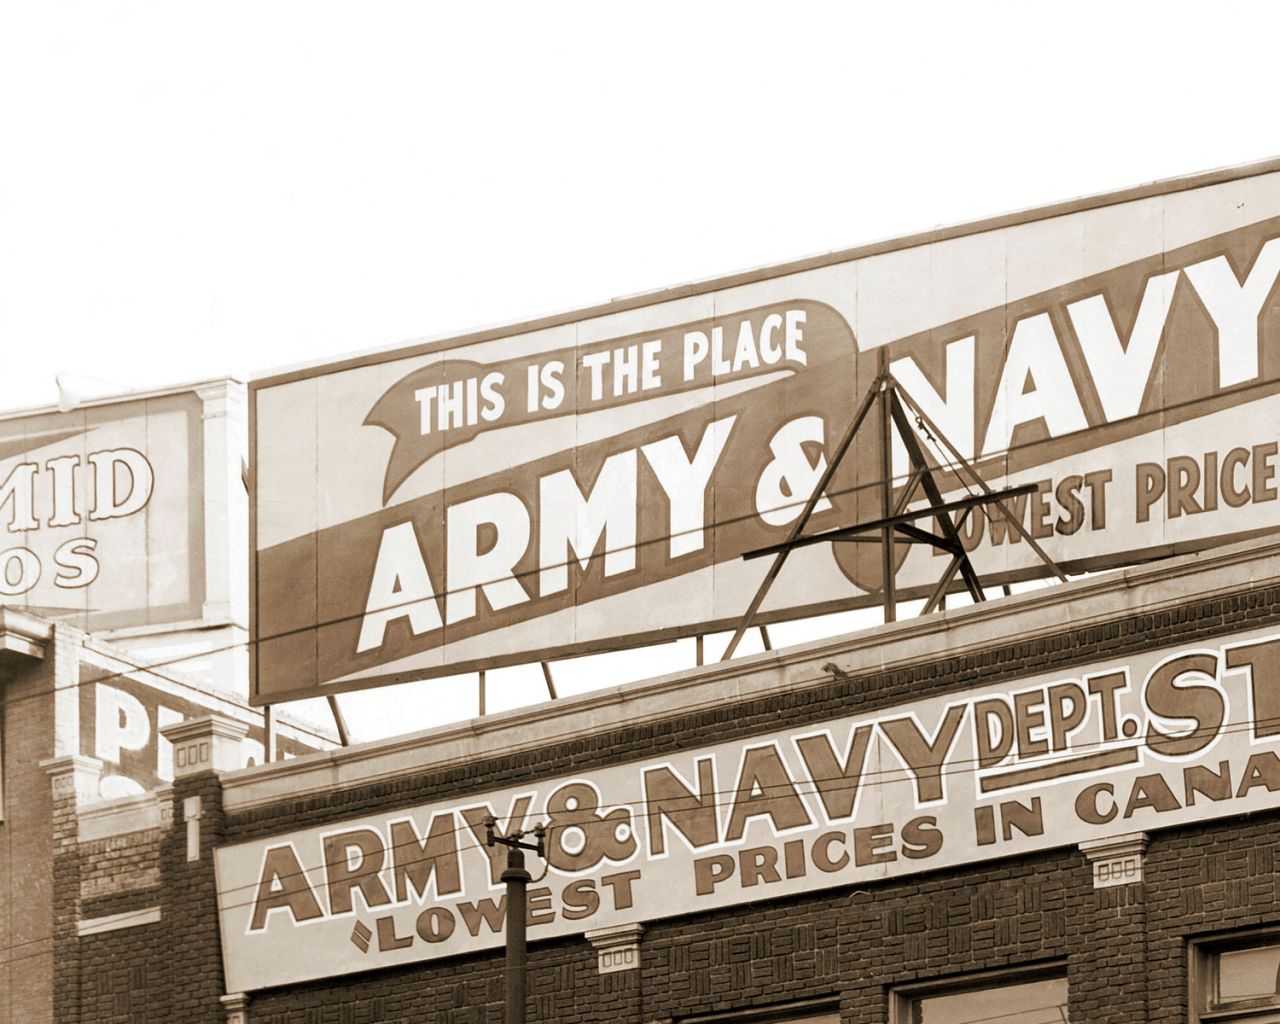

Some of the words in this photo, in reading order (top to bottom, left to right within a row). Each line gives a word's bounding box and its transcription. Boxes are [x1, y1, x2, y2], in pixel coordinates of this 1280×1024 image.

[415, 371, 506, 436] THIS
[526, 361, 566, 411] IS
[582, 339, 662, 402] THE
[682, 310, 807, 386] PLACE
[356, 415, 738, 653] ARMY
[754, 416, 834, 526] &
[247, 793, 536, 933] ARMY
[543, 783, 637, 872] &
[644, 706, 965, 856] NAVY
[976, 671, 1138, 770] DEPT.
[377, 869, 642, 953] LOWEST
[694, 816, 943, 896] PRICES
[975, 797, 1044, 846] IN
